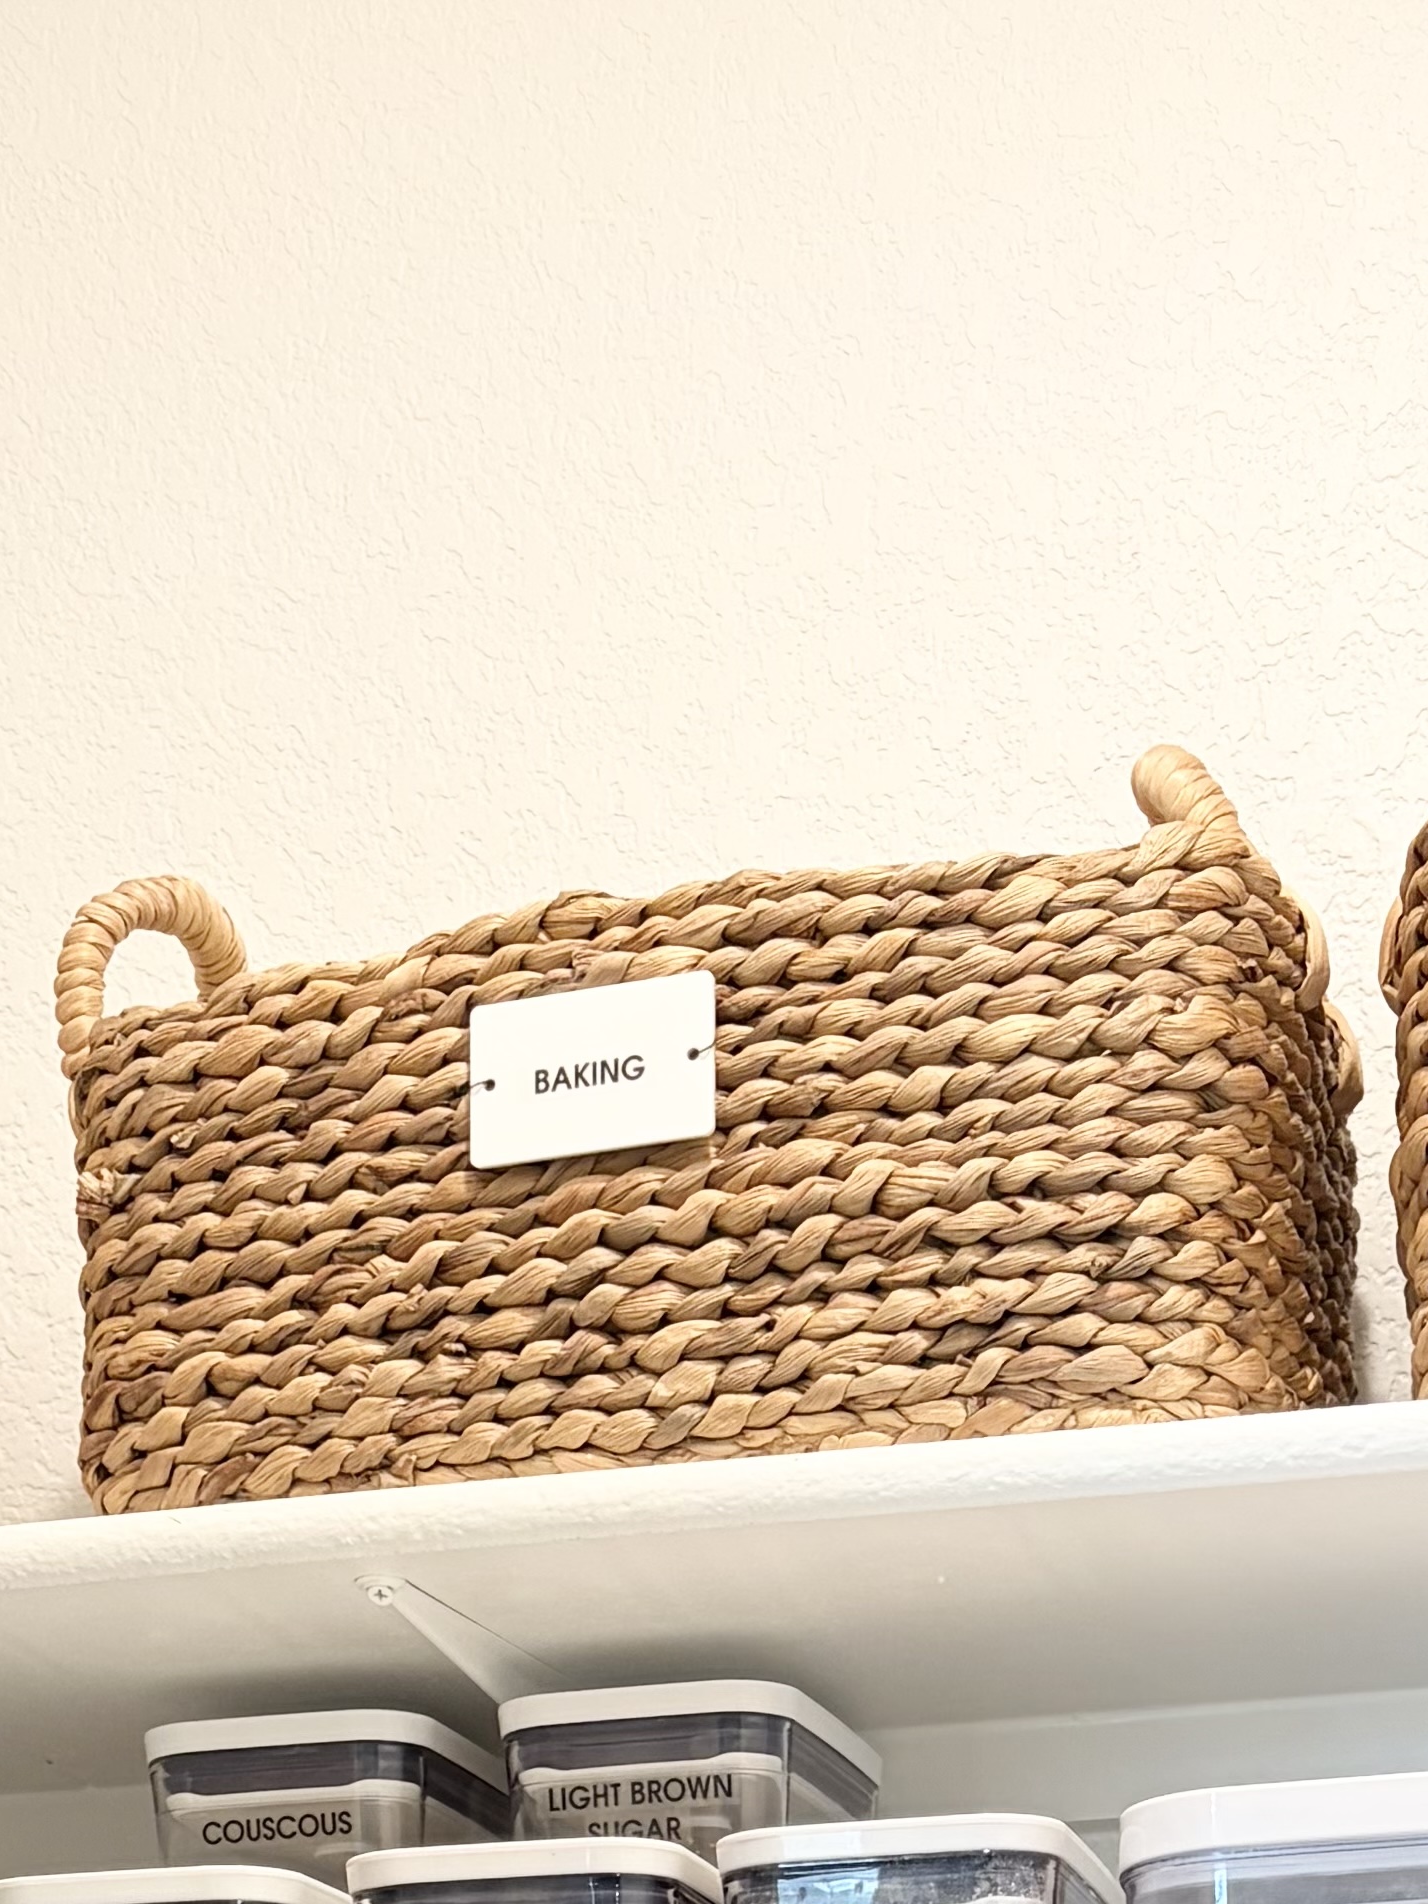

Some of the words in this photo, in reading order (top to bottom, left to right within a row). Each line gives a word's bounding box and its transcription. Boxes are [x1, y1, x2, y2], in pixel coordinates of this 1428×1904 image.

[534, 1054, 646, 1095] BAKING
[546, 1782, 622, 1812] LIGHT
[631, 1773, 734, 1806] BROWN
[201, 1809, 353, 1846] COUSCOUS
